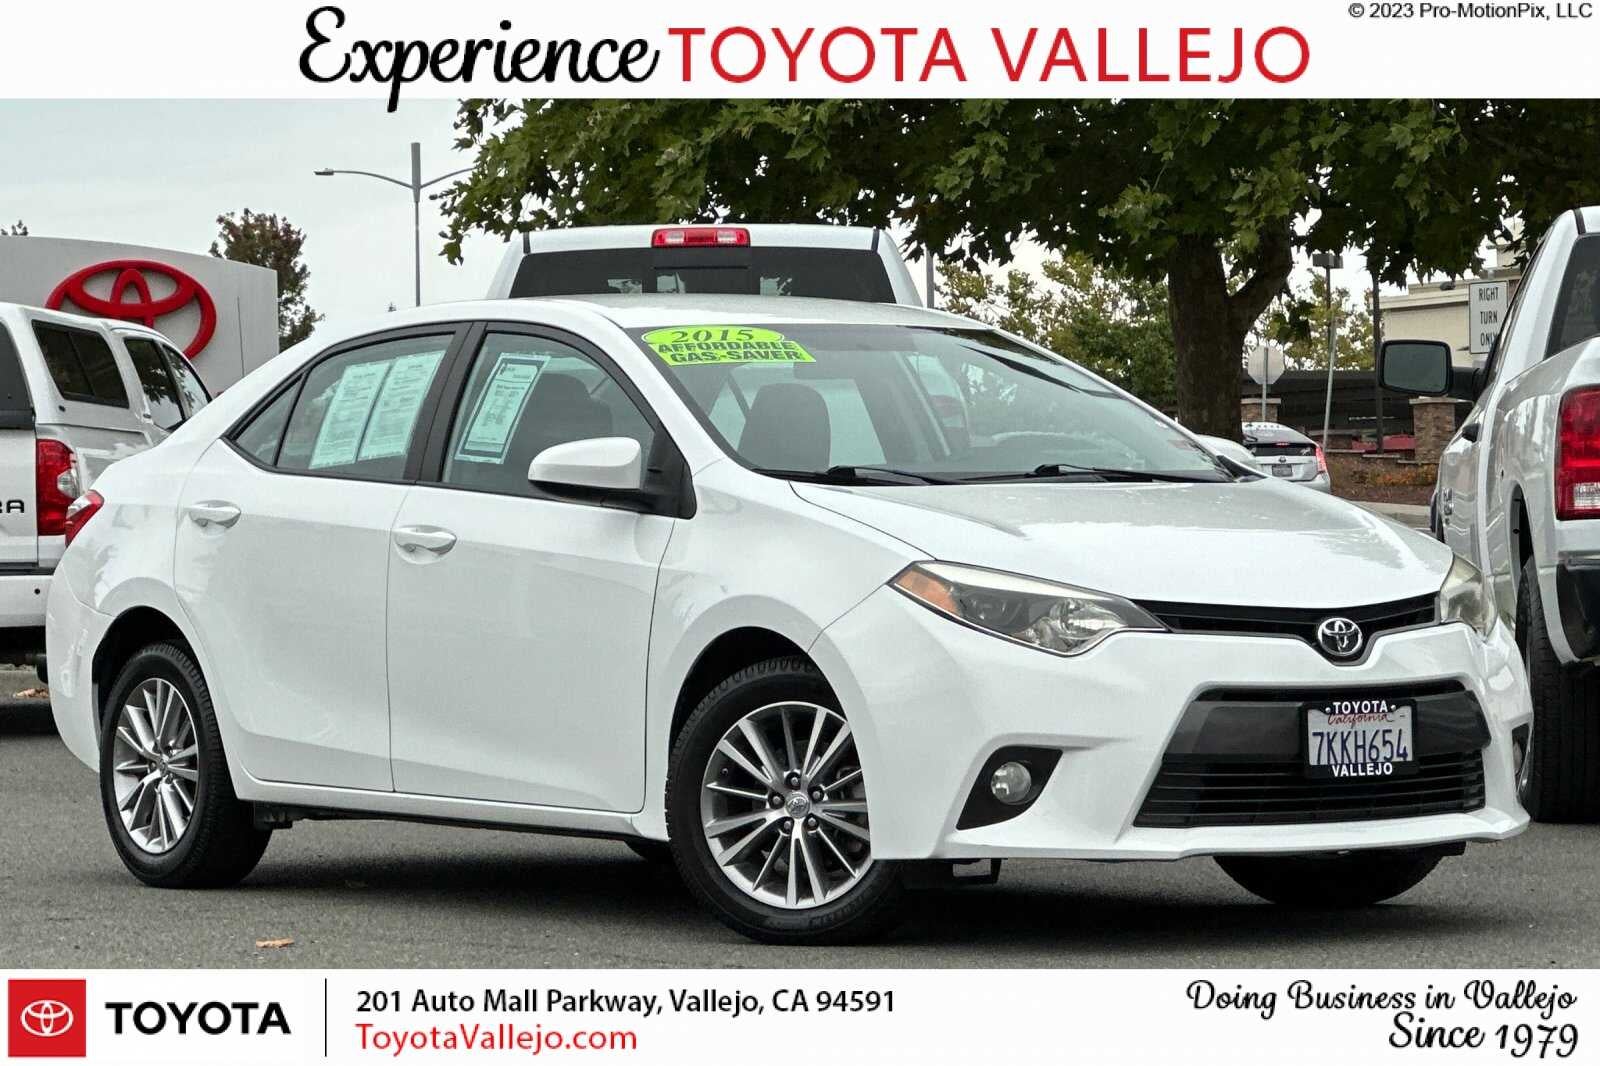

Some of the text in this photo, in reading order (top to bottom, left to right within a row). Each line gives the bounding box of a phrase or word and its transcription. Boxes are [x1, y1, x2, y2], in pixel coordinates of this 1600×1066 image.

[1479, 287, 1499, 301] RIGHT
[1480, 311, 1498, 324] TURN
[671, 329, 755, 343] 2015
[658, 341, 796, 353] AFFORDABLE
[670, 350, 802, 363] GAS-SAVER
[0, 499, 25, 513] A
[1332, 700, 1388, 714] TOYOTA
[1312, 728, 1408, 765] 7KKH654
[1332, 762, 1393, 777] VALLEJO
